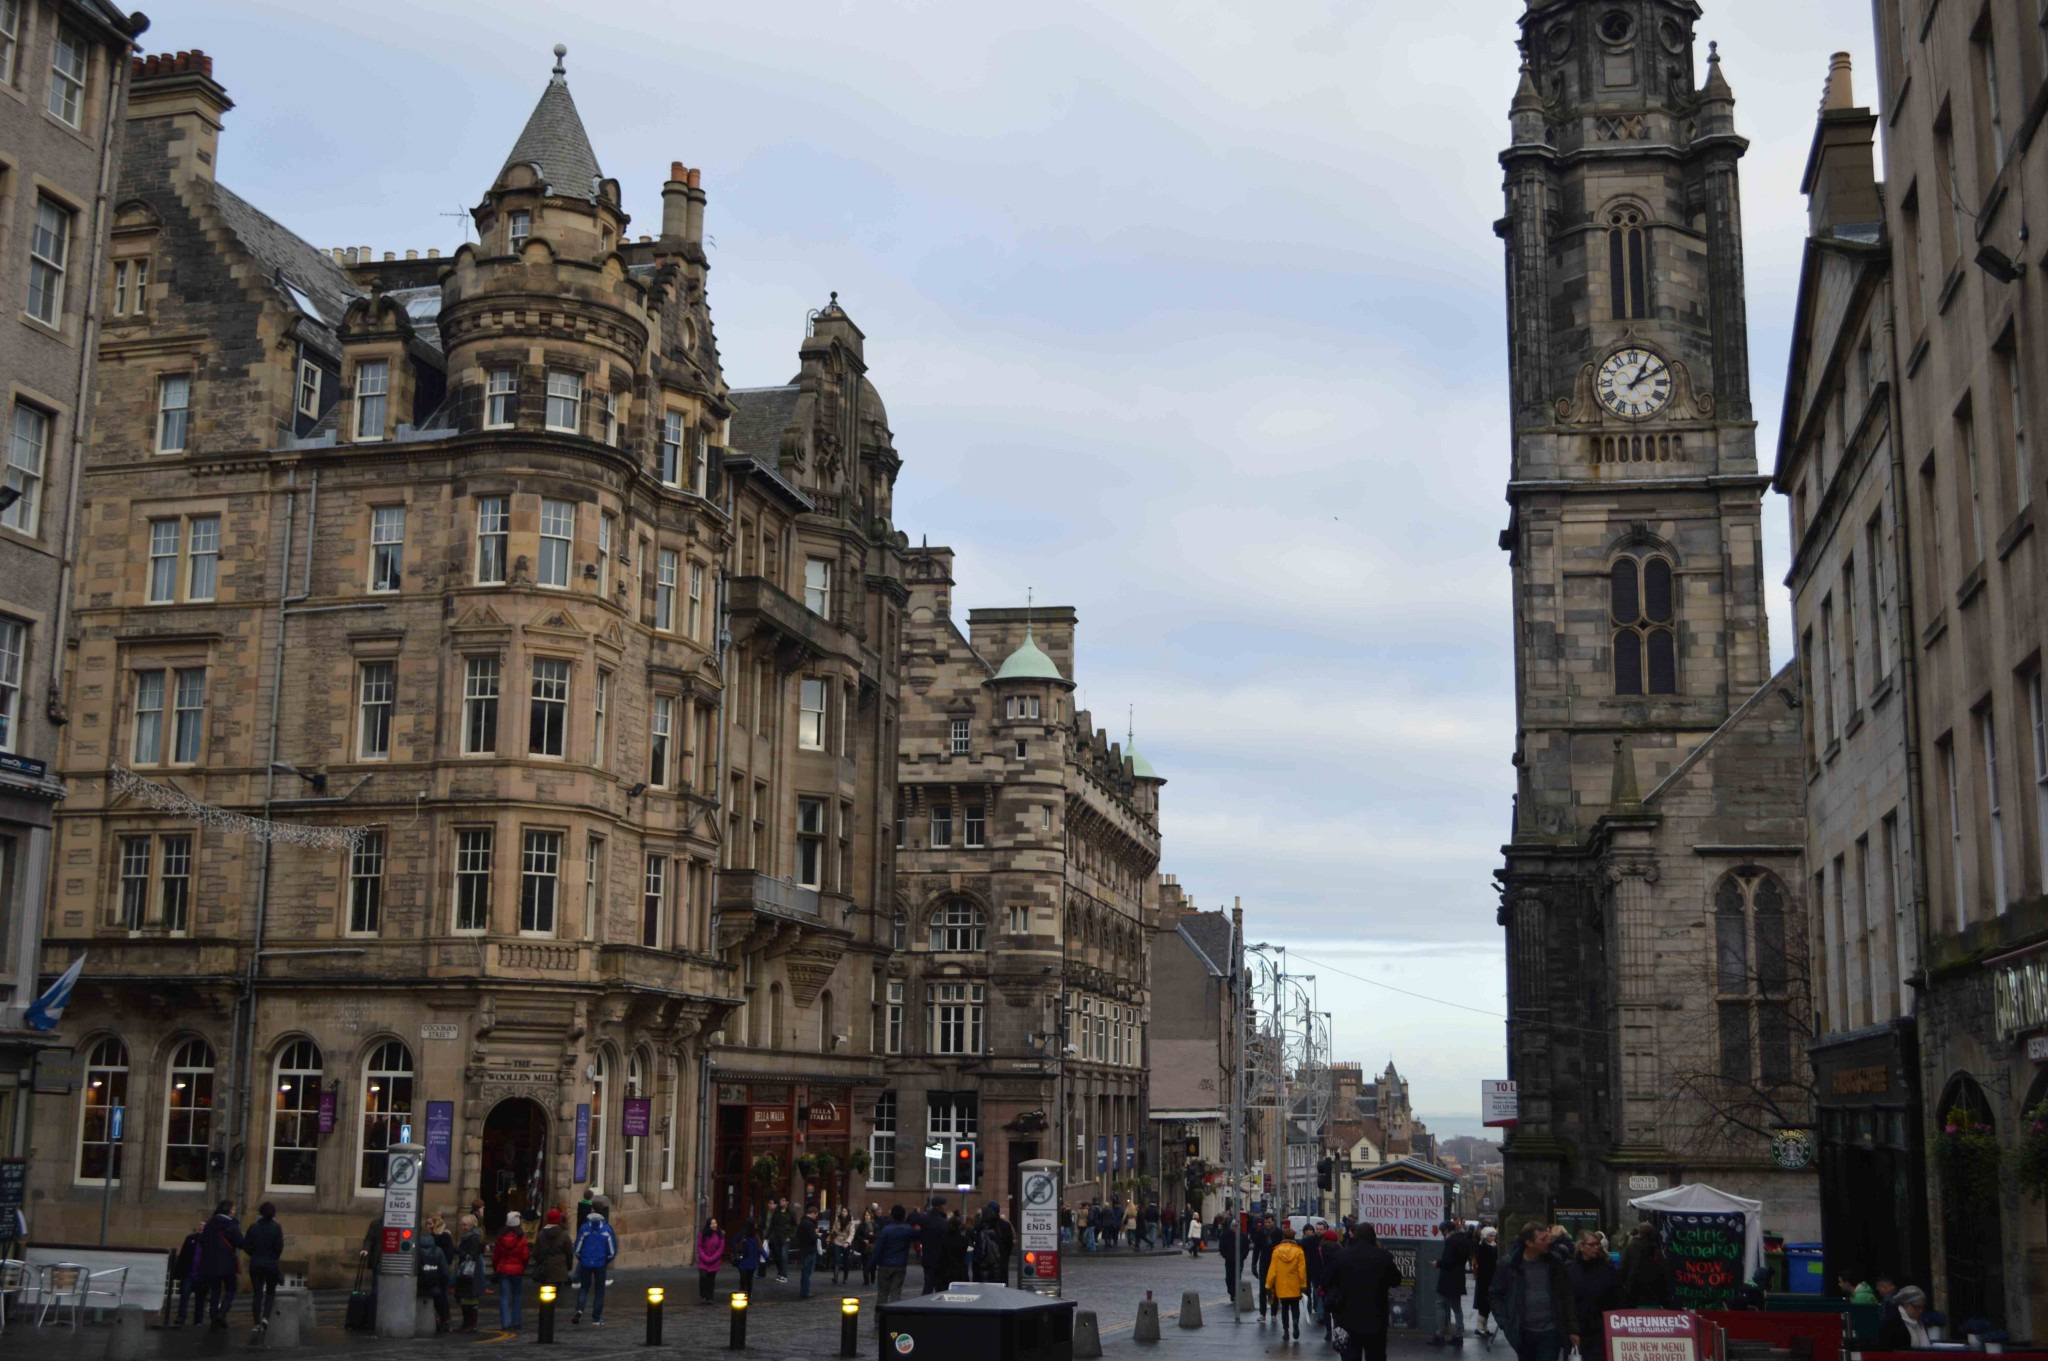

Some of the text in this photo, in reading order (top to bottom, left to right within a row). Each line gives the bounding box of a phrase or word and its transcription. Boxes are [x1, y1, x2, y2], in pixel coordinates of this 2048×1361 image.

[488, 1073, 555, 1082] WOOLLEN MILL
[1495, 1082, 1508, 1092] TO
[1774, 1130, 1809, 1147] STARBUCKS
[1778, 1156, 1806, 1167] COFFEE
[1361, 1193, 1443, 1207] UNDERGROUND
[1365, 1207, 1438, 1219] GHOST TOURS
[1400, 1225, 1428, 1237] HERE
[1393, 1256, 1416, 1266] HOST
[1685, 1260, 1721, 1273] NOW
[1674, 1269, 1733, 1285] 50% OFF
[1610, 1314, 1690, 1329] GARFUNKEL'S
[1620, 1341, 1685, 1352] OUR NEW MENU
[1622, 1353, 1641, 1361] HAS
